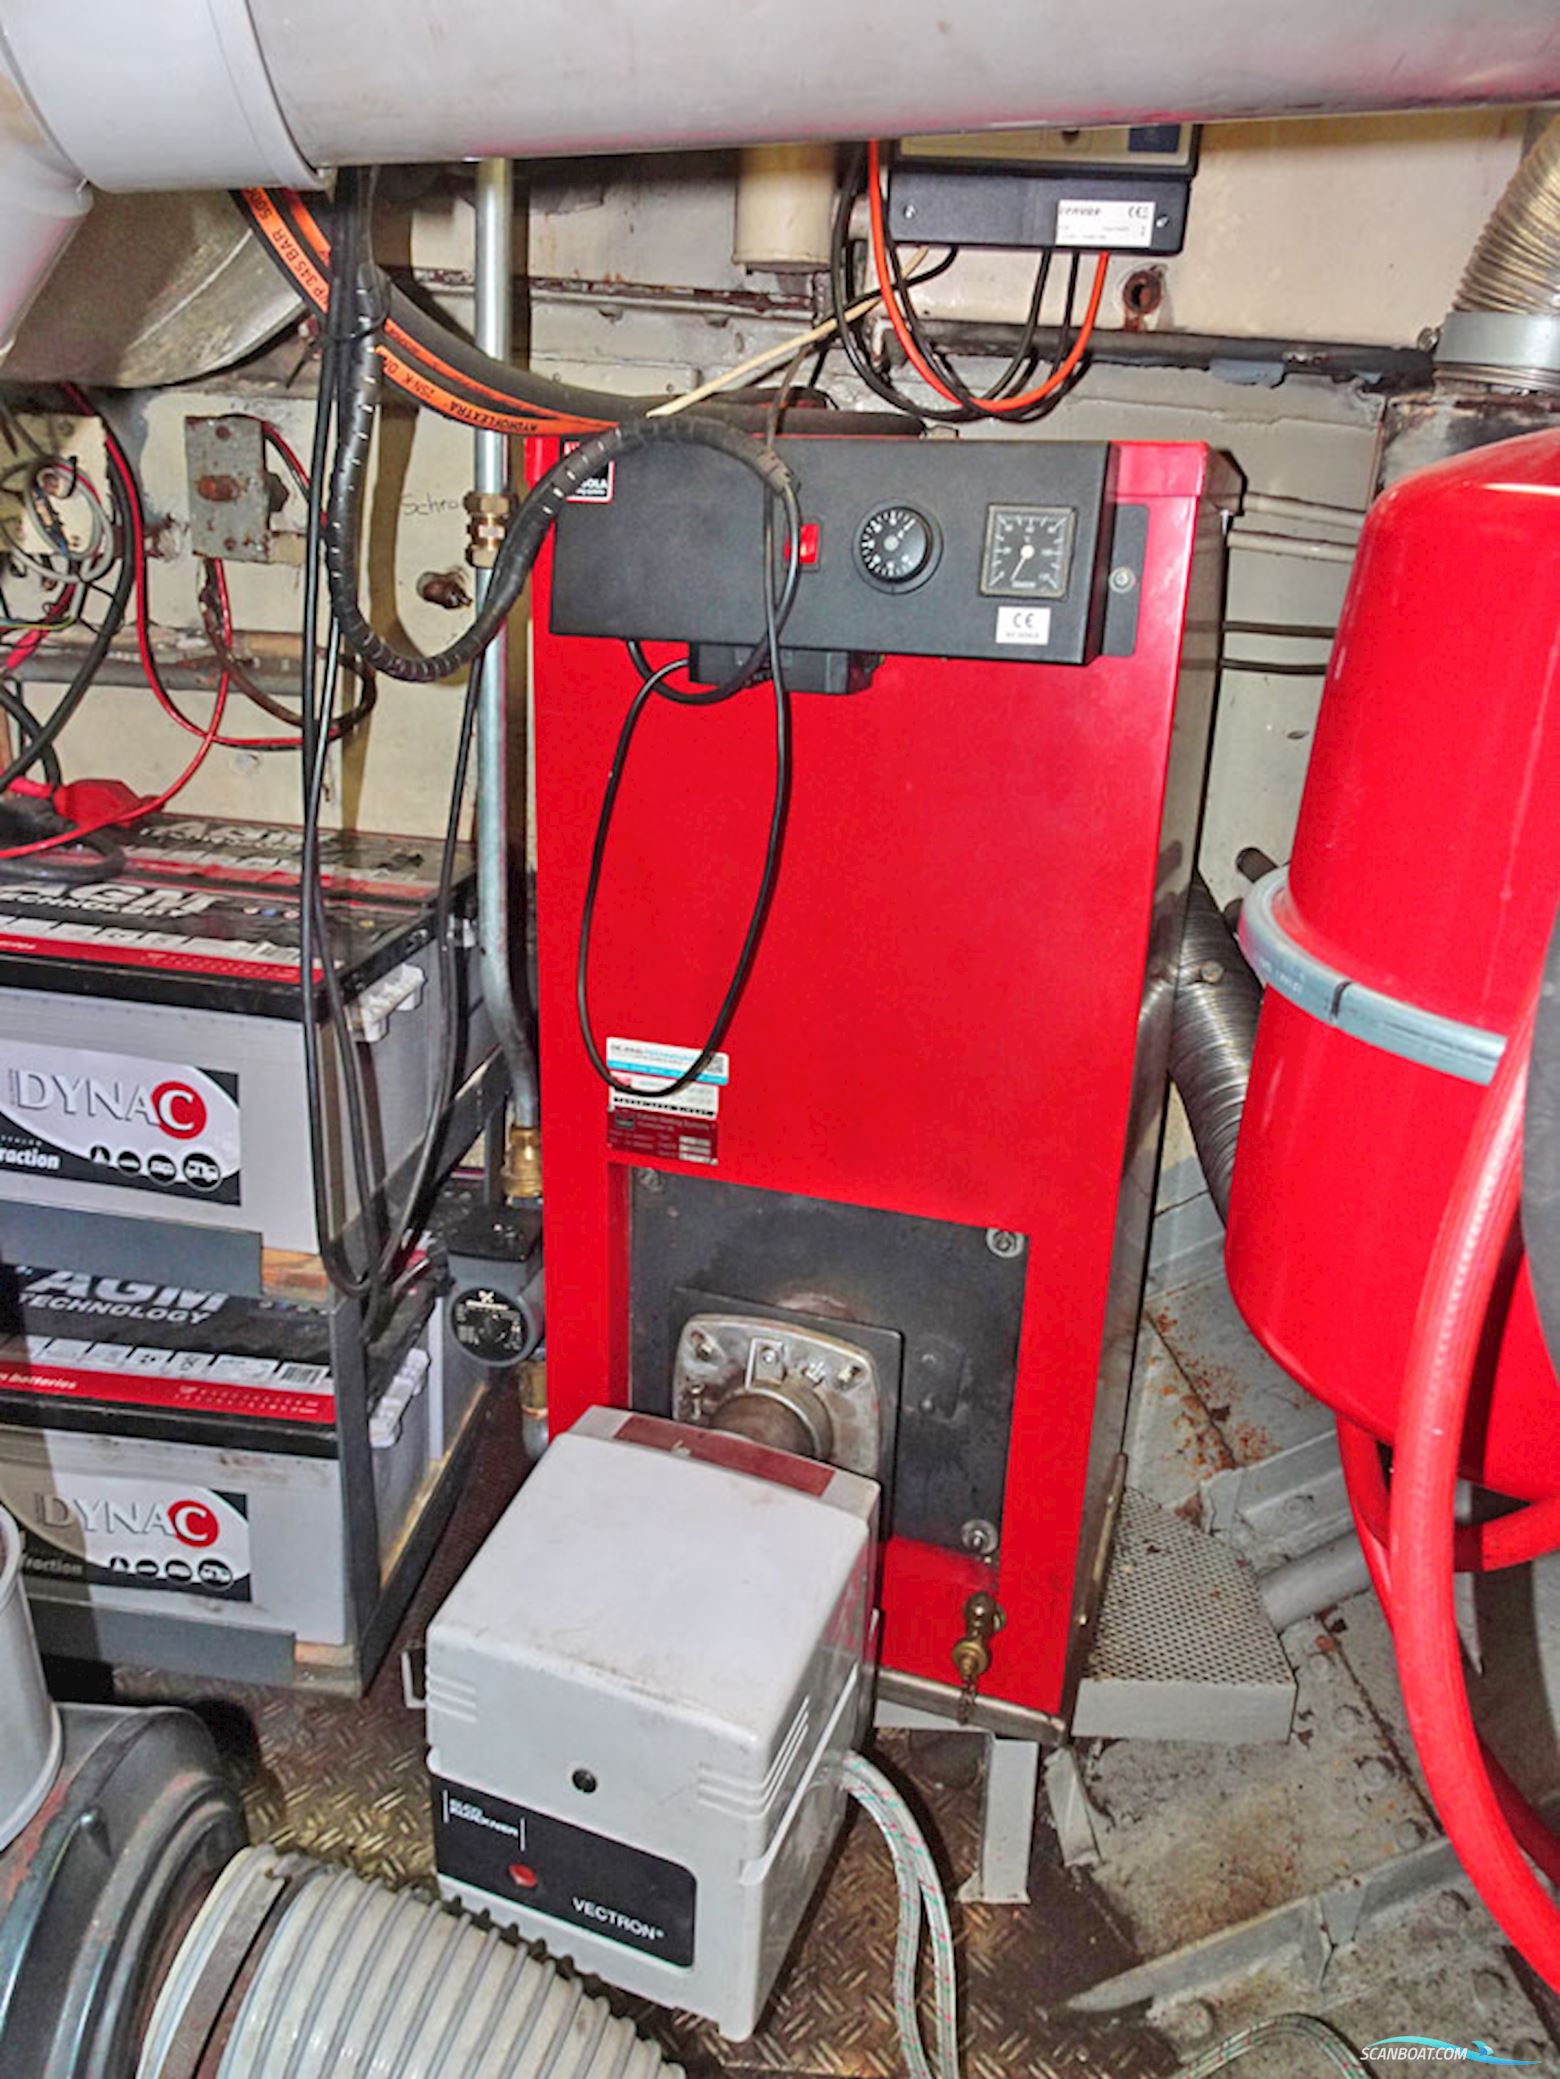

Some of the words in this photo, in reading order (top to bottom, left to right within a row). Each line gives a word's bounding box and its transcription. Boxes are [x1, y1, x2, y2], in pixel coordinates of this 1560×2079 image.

[271, 228, 301, 262] BAR
[294, 260, 319, 288] 345
[15, 1069, 196, 1132] DYNAC
[18, 1291, 213, 1325] TECHNOLOGY
[42, 1493, 209, 1542] DYNAC
